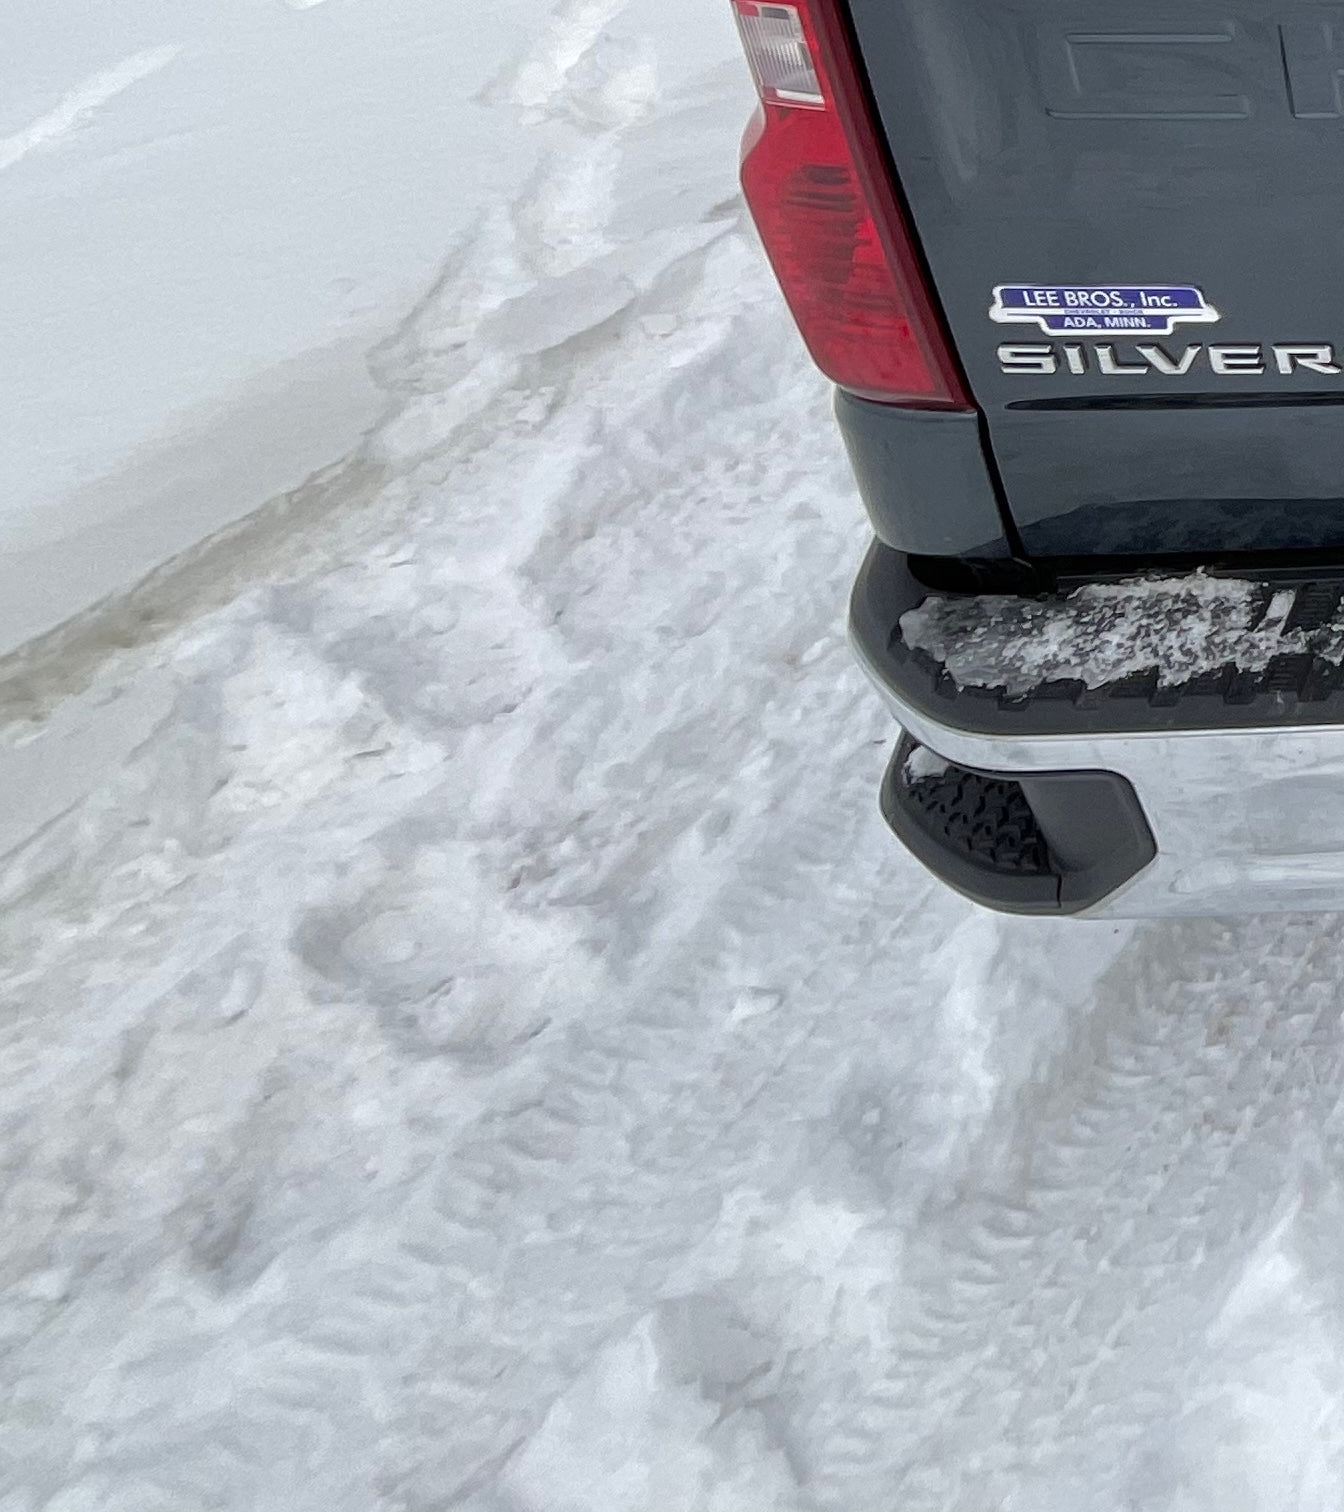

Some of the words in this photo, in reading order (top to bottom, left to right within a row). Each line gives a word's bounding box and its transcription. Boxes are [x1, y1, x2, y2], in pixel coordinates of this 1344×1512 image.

[1022, 290, 1060, 307] LEE
[1139, 291, 1178, 307] Inc.
[1104, 316, 1151, 328] MINN.
